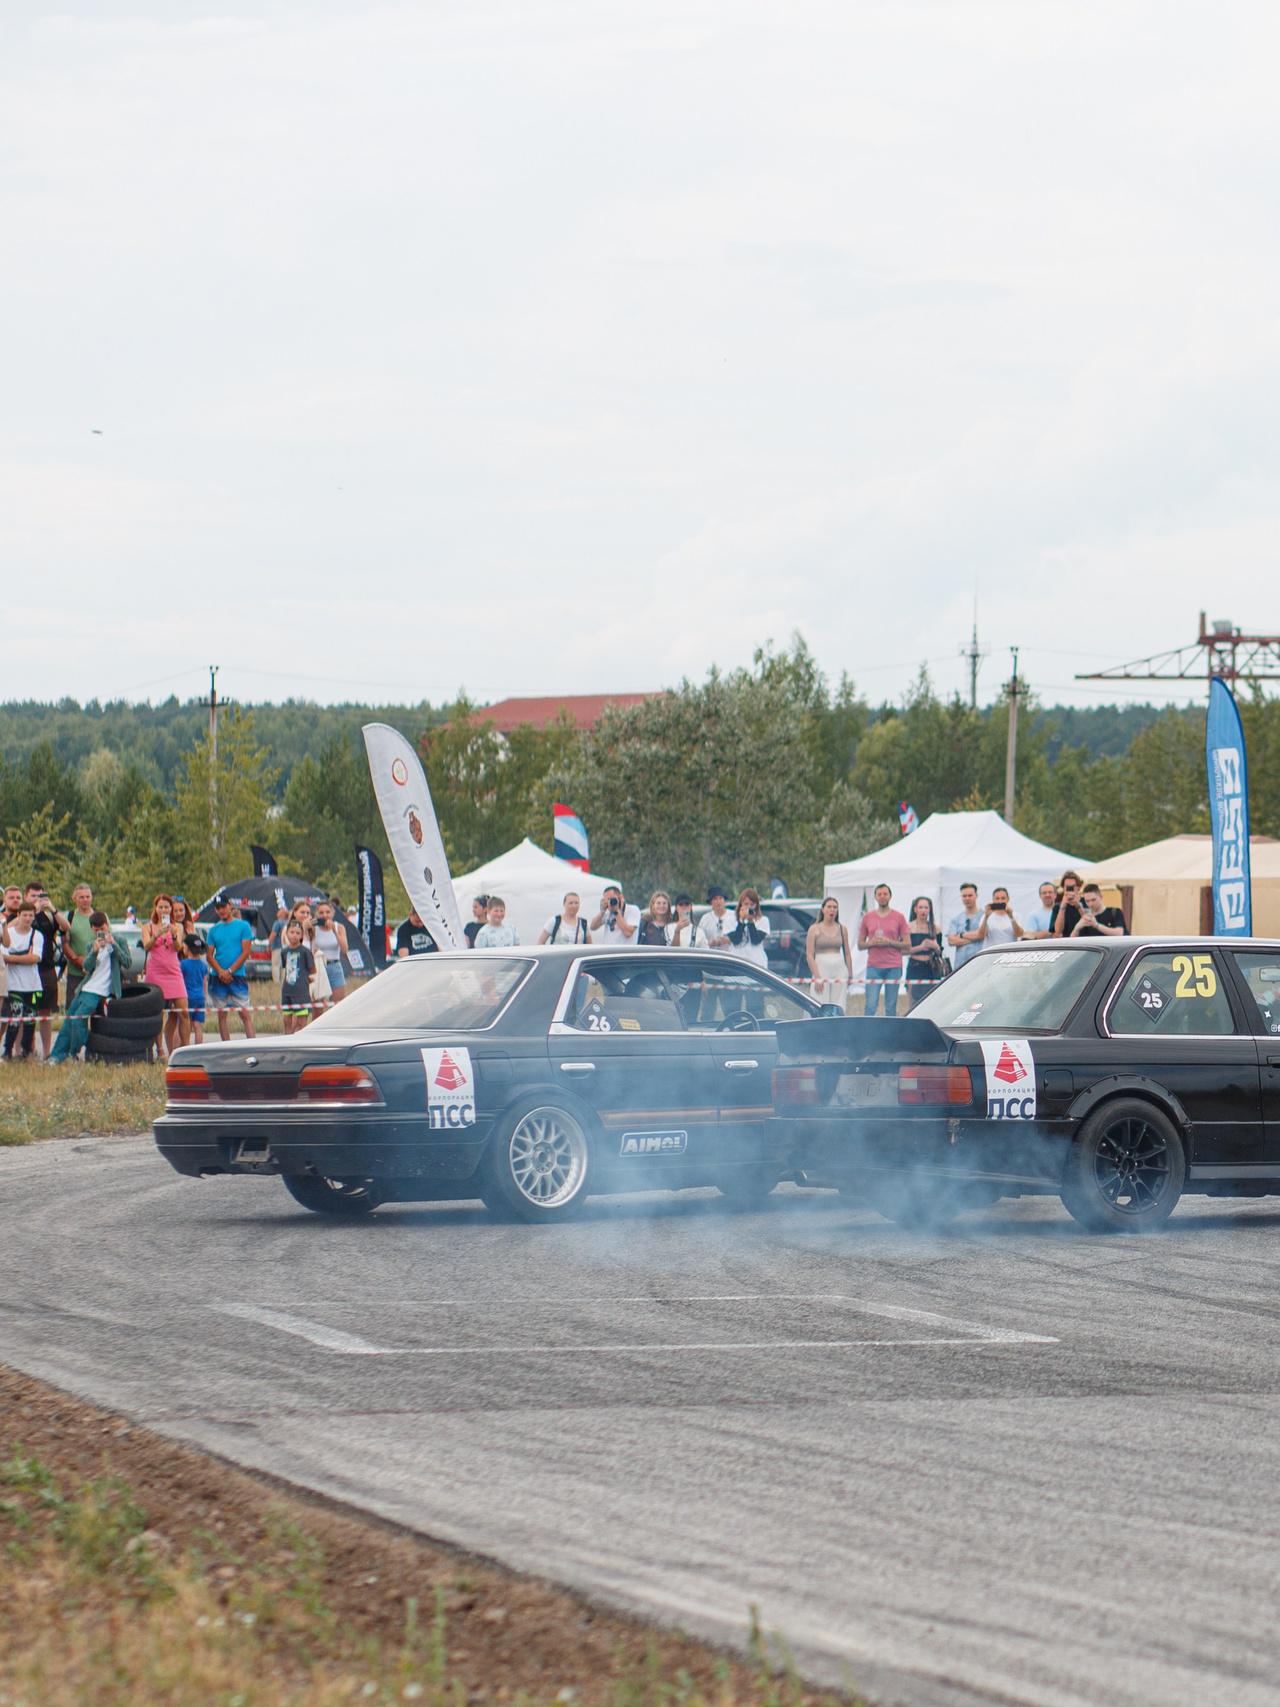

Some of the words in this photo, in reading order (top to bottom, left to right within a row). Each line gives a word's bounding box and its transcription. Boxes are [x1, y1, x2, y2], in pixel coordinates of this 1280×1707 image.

[1172, 955, 1217, 998] 25
[1141, 992, 1163, 1009] 25
[588, 1014, 611, 1032] 26
[428, 1104, 474, 1128] ПСС
[987, 1097, 1035, 1119] ПСС
[622, 1136, 684, 1153] AIMOL
